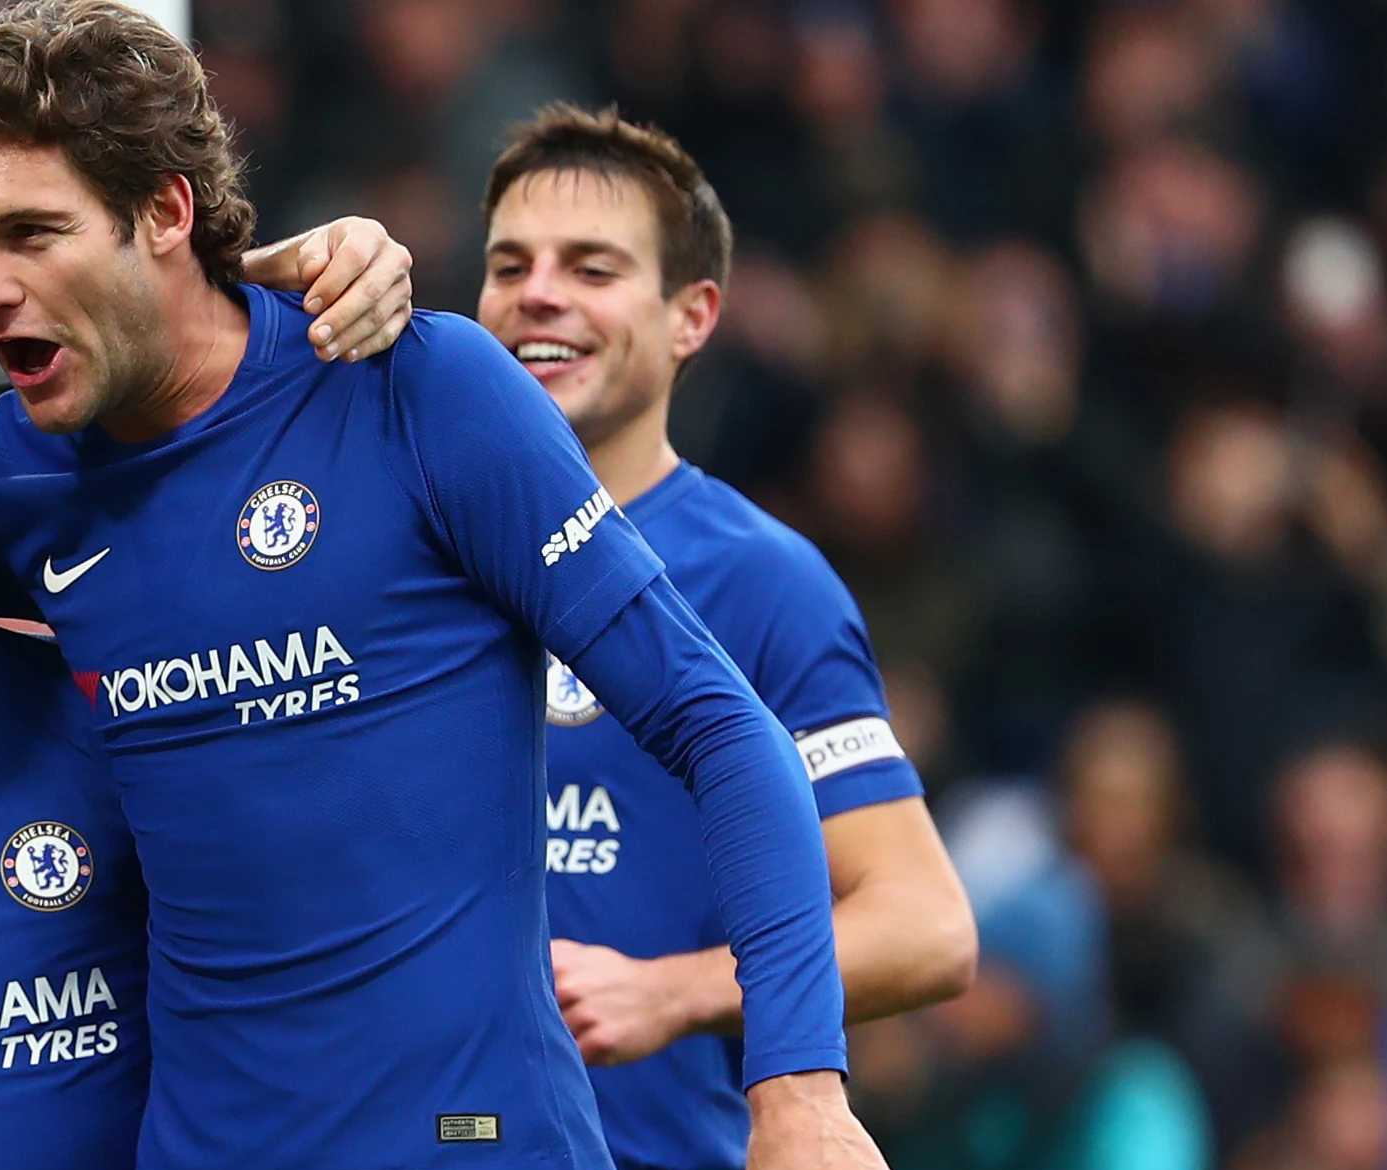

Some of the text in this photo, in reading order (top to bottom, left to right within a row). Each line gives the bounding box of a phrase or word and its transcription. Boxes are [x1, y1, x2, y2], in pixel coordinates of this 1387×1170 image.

[250, 484, 303, 508] CHELSEA
[251, 542, 306, 566] FOOTBALL CLUB
[101, 625, 354, 717] YOKOHAMA
[12, 825, 70, 849] CHELSEA
[22, 893, 63, 907] FOOTBALL
[1, 1021, 119, 1069] TYRES
